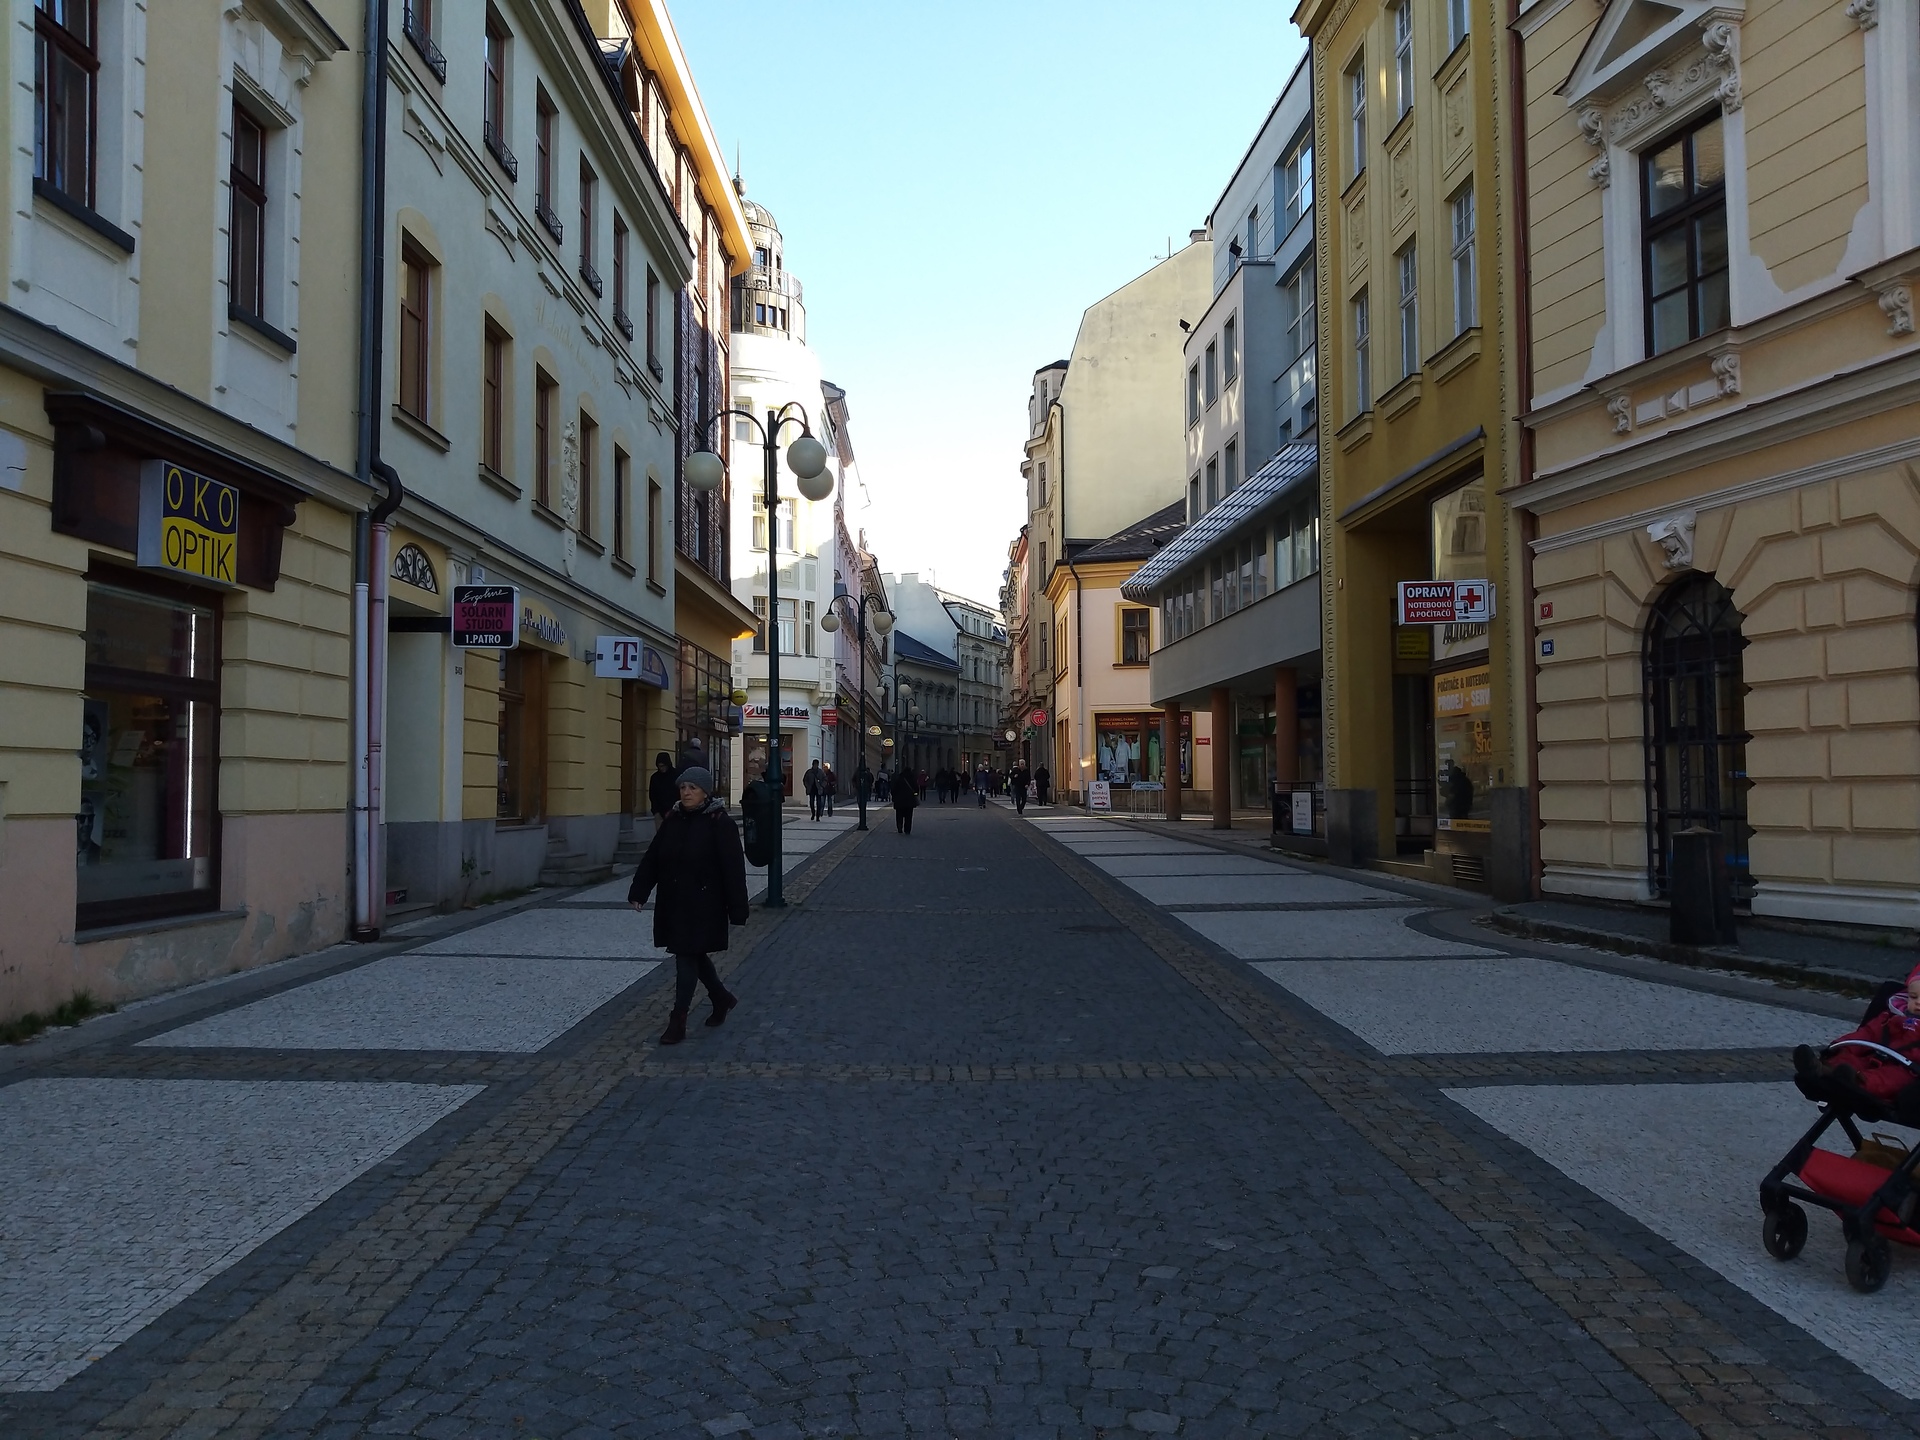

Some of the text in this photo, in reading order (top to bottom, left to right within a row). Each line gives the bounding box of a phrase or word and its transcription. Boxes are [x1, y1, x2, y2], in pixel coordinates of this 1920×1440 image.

[165, 525, 233, 582] OPTIK
[1406, 586, 1452, 599] OPRAVY
[461, 603, 507, 618] SOLÁRNÍ
[1407, 600, 1452, 610] NOTEBOOKŮ
[1410, 608, 1451, 619] A POČÍTAČŮ
[466, 618, 504, 631] STUDIO
[465, 634, 502, 645] 1.PATRO
[614, 641, 638, 671] T
[1437, 676, 1459, 693] POČÍTAČE
[1437, 692, 1464, 712] PRODEJ
[756, 706, 810, 717] Uniedit Bank
